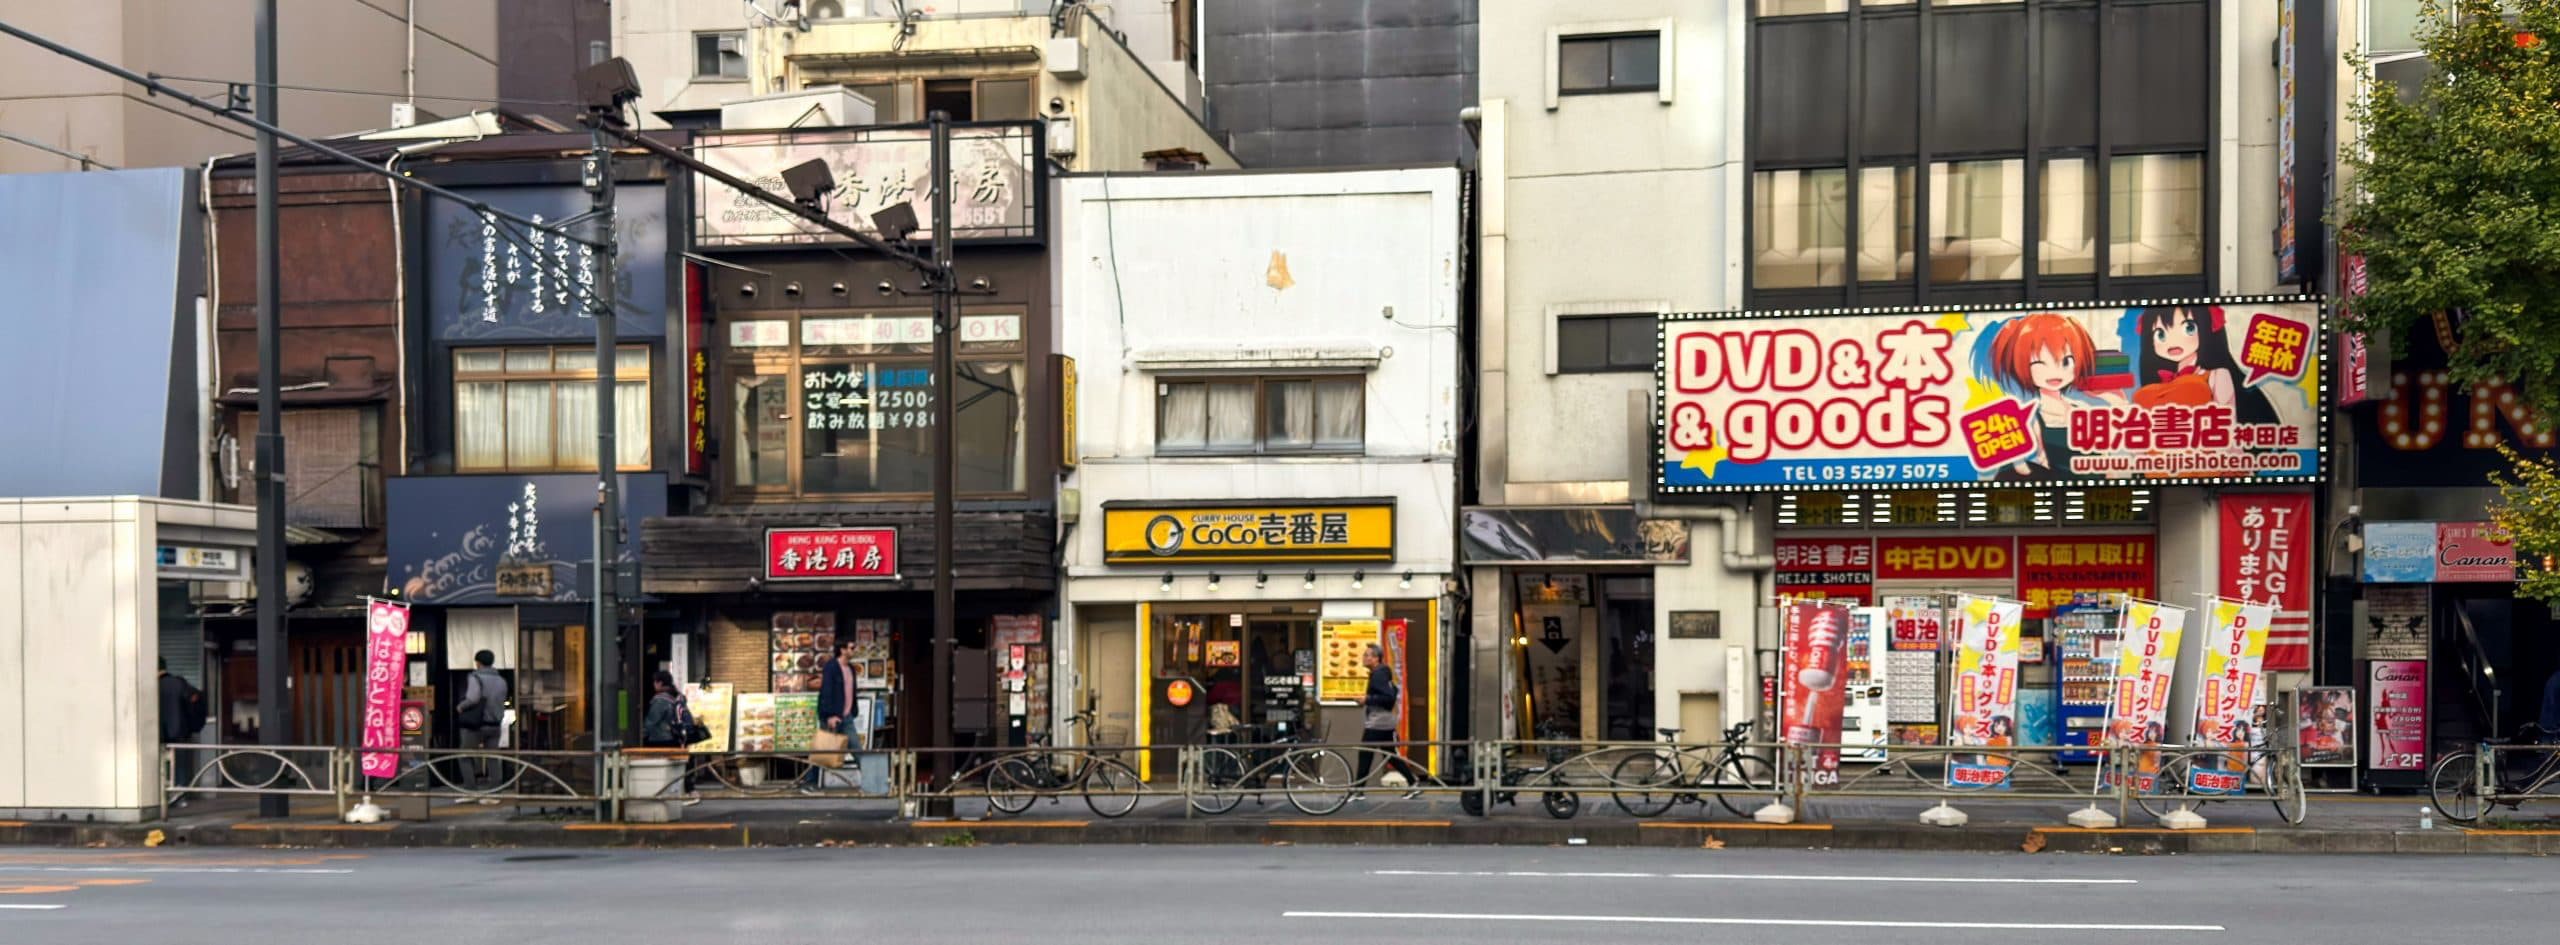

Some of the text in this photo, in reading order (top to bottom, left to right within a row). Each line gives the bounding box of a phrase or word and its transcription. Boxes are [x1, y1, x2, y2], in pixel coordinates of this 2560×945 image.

[2252, 319, 2303, 350] 年中
[1676, 320, 1953, 393] DVD & 本
[2247, 342, 2297, 371] 無休
[1670, 387, 1951, 463] & goods
[1968, 411, 2021, 443] 24h
[2070, 404, 2299, 452] 明治書店 神田店
[1976, 431, 2026, 460] OPEN
[1783, 464, 1950, 481] TEL 03 5297 5075
[2072, 451, 2299, 474] www.meijishoten.com
[1191, 514, 1255, 522] CURRY HOUSE
[1192, 512, 1348, 545] CoCo壱番屋
[778, 546, 883, 571] 香港厨房
[1776, 544, 1870, 567] 明治書店
[1884, 546, 2006, 571] 中古DVD
[2264, 507, 2291, 612] TENGA
[2440, 544, 2508, 566] Canan
[1777, 572, 1870, 584] MEIJI SHOTEN
[1896, 618, 1939, 640] 明治
[2375, 665, 2420, 681] Canan
[2400, 753, 2423, 767] 2F
